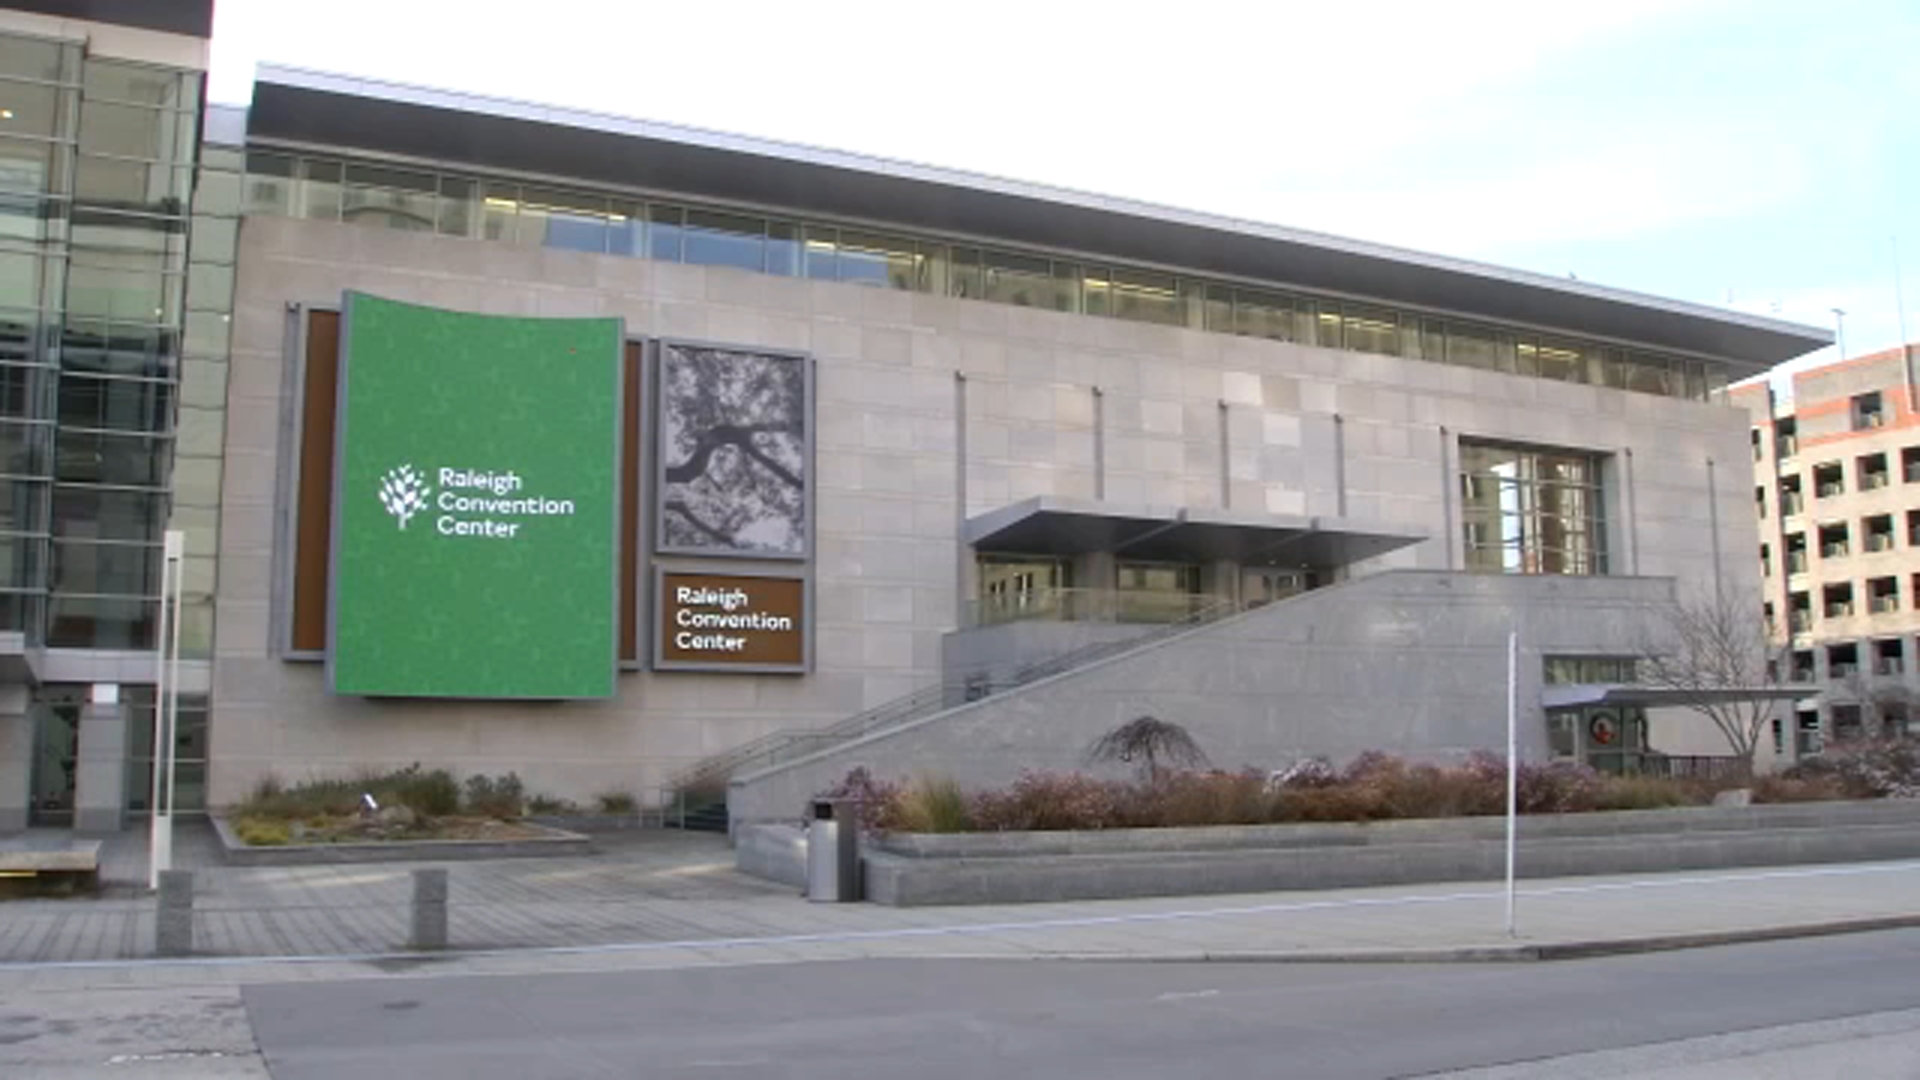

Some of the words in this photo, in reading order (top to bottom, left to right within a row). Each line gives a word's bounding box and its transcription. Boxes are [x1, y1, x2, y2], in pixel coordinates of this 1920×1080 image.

[438, 466, 523, 496] Raleigh
[437, 491, 575, 515] Convention
[436, 515, 519, 538] Center
[676, 586, 749, 611] Raleigh
[676, 608, 792, 630] Convention
[675, 631, 747, 650] Center
